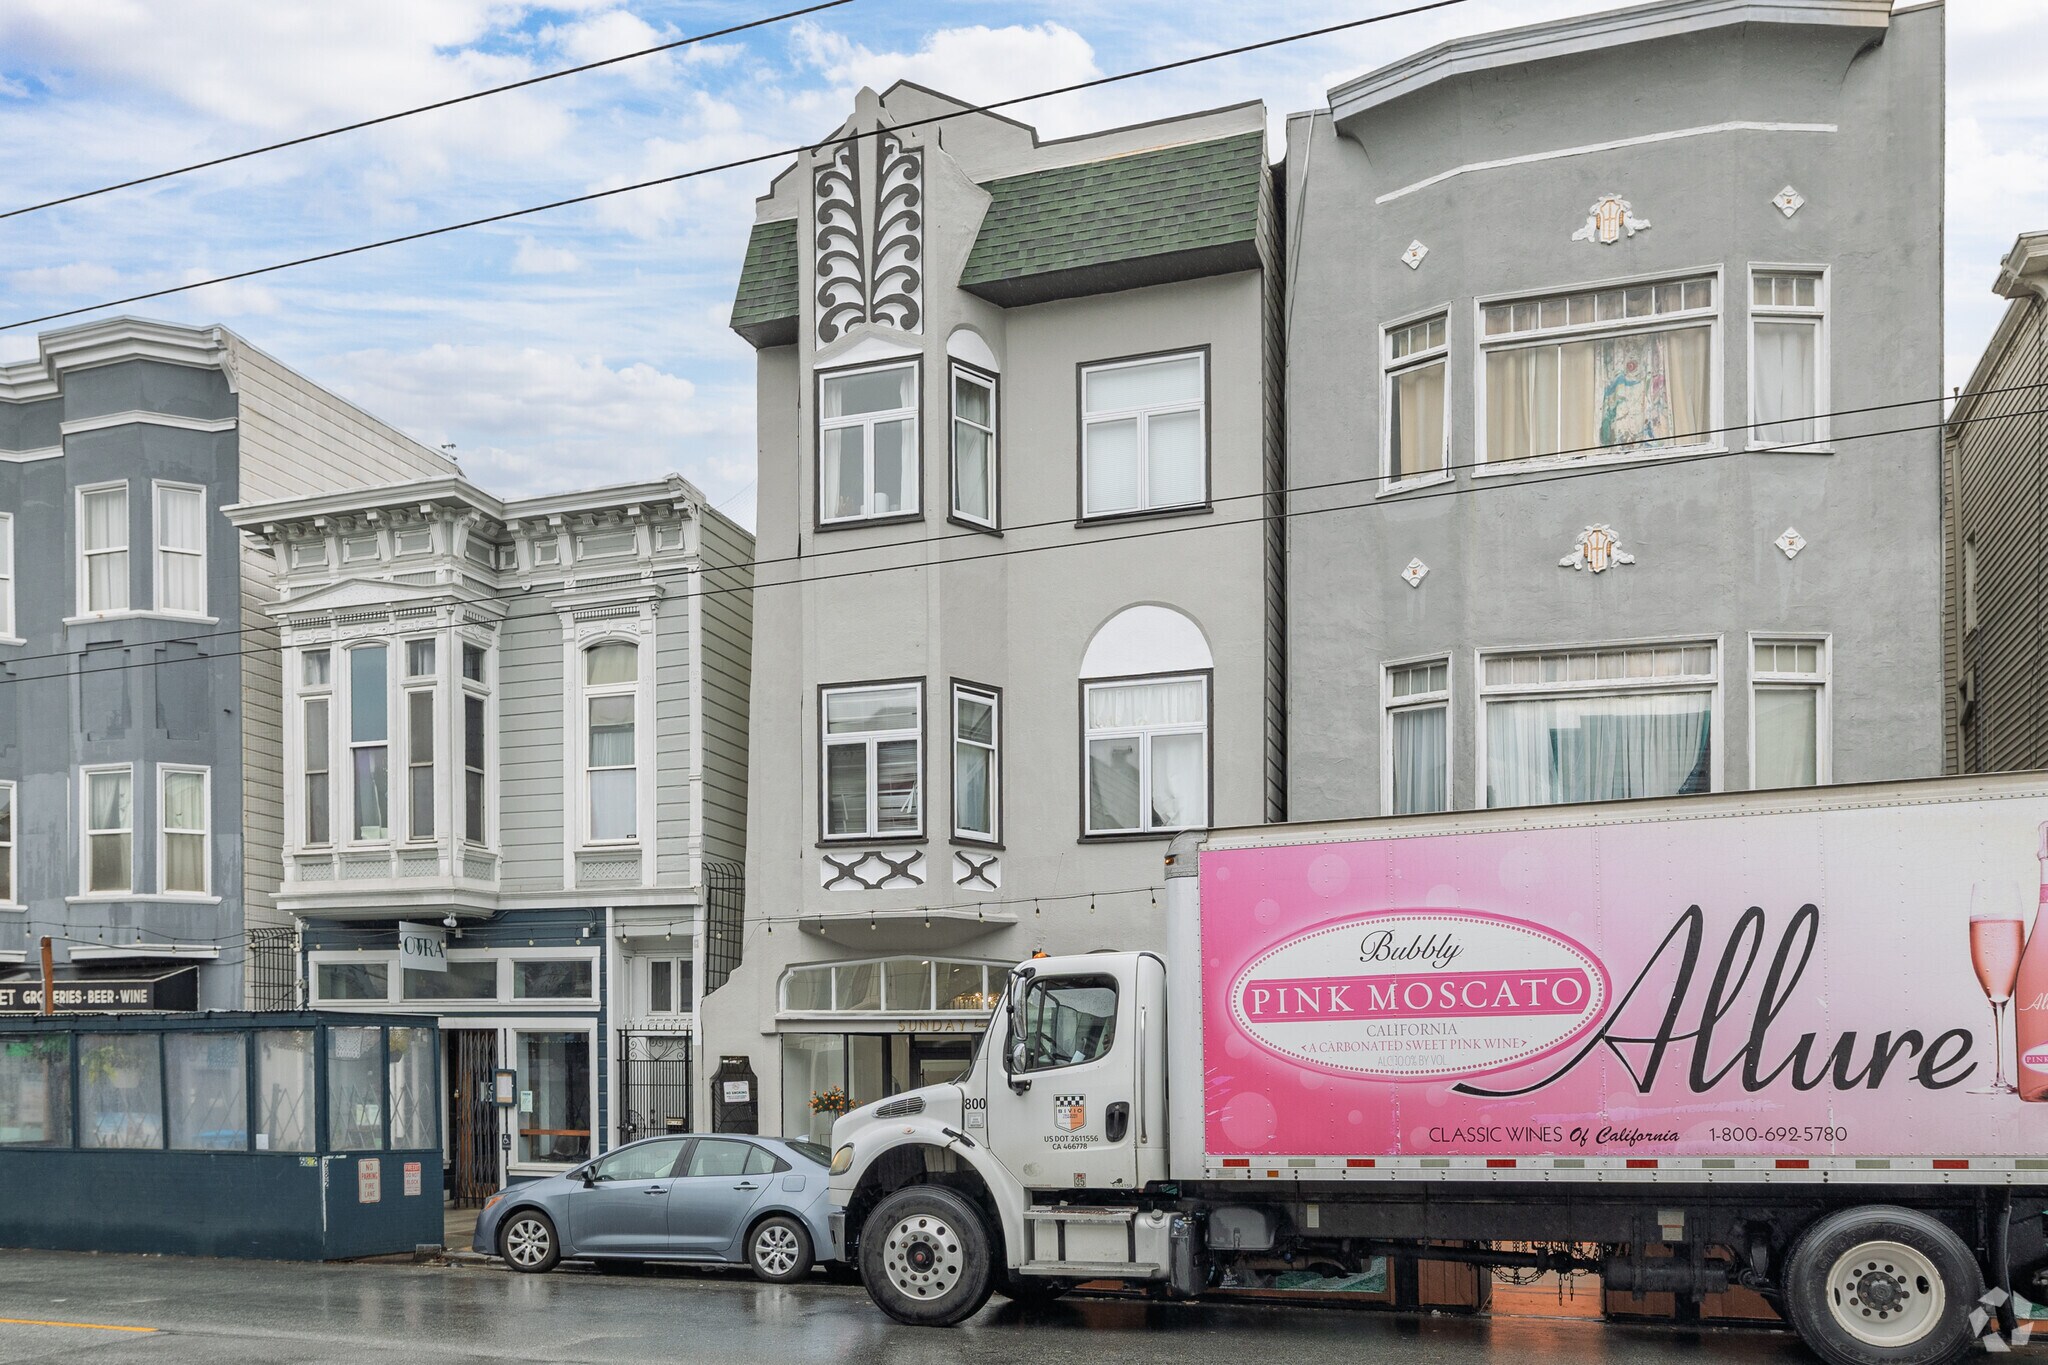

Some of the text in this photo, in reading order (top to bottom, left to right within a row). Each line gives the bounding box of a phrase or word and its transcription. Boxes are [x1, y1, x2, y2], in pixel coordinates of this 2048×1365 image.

[1360, 930, 1464, 969] Bubbly
[22, 990, 82, 1005] GROERIES
[87, 989, 115, 1004] BEER
[119, 989, 148, 1004] WINE
[1251, 976, 1584, 1015] PINK MOSCATO
[1454, 903, 1979, 1096] Allure
[898, 1019, 967, 1032] SUNDAY
[1366, 1022, 1459, 1038] CALIFORNIA
[1308, 1038, 1520, 1053] A CARBONATED SWEET PINK WINE
[964, 1097, 986, 1110] 800
[1044, 1135, 1053, 1143] US
[1055, 1135, 1069, 1143] DOT
[1428, 1125, 1848, 1146] CLASSIC WINES Of California 1-800-692-5780
[365, 1163, 373, 1171] NO
[361, 1172, 378, 1180] PARKING
[365, 1182, 374, 1190] FIRE
[364, 1190, 375, 1198] LANE
